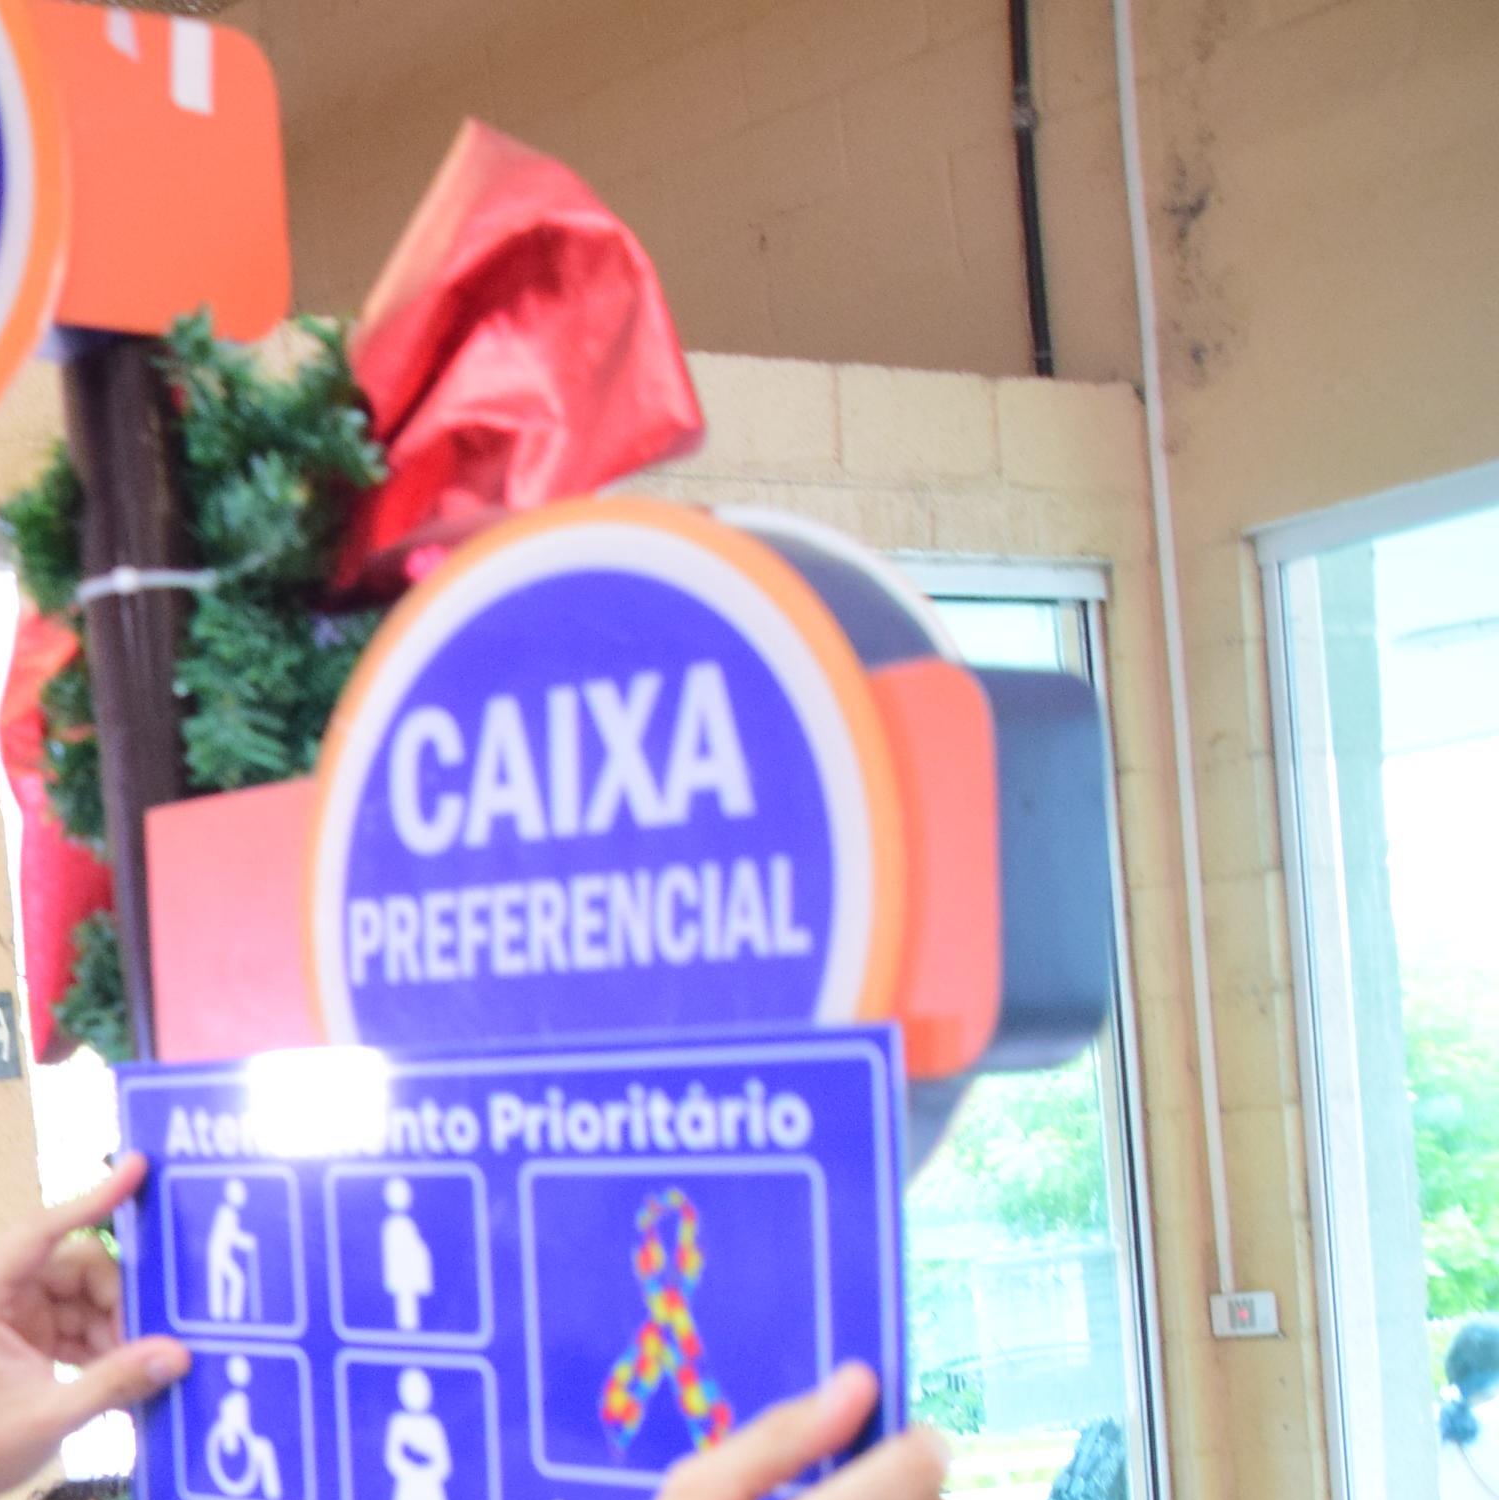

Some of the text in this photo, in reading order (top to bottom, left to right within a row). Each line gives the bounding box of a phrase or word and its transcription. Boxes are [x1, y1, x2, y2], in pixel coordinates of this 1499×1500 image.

[387, 660, 757, 856] CAIXA
[348, 854, 811, 988] PREFERENCIAL
[488, 1077, 815, 1156] Prioritário
